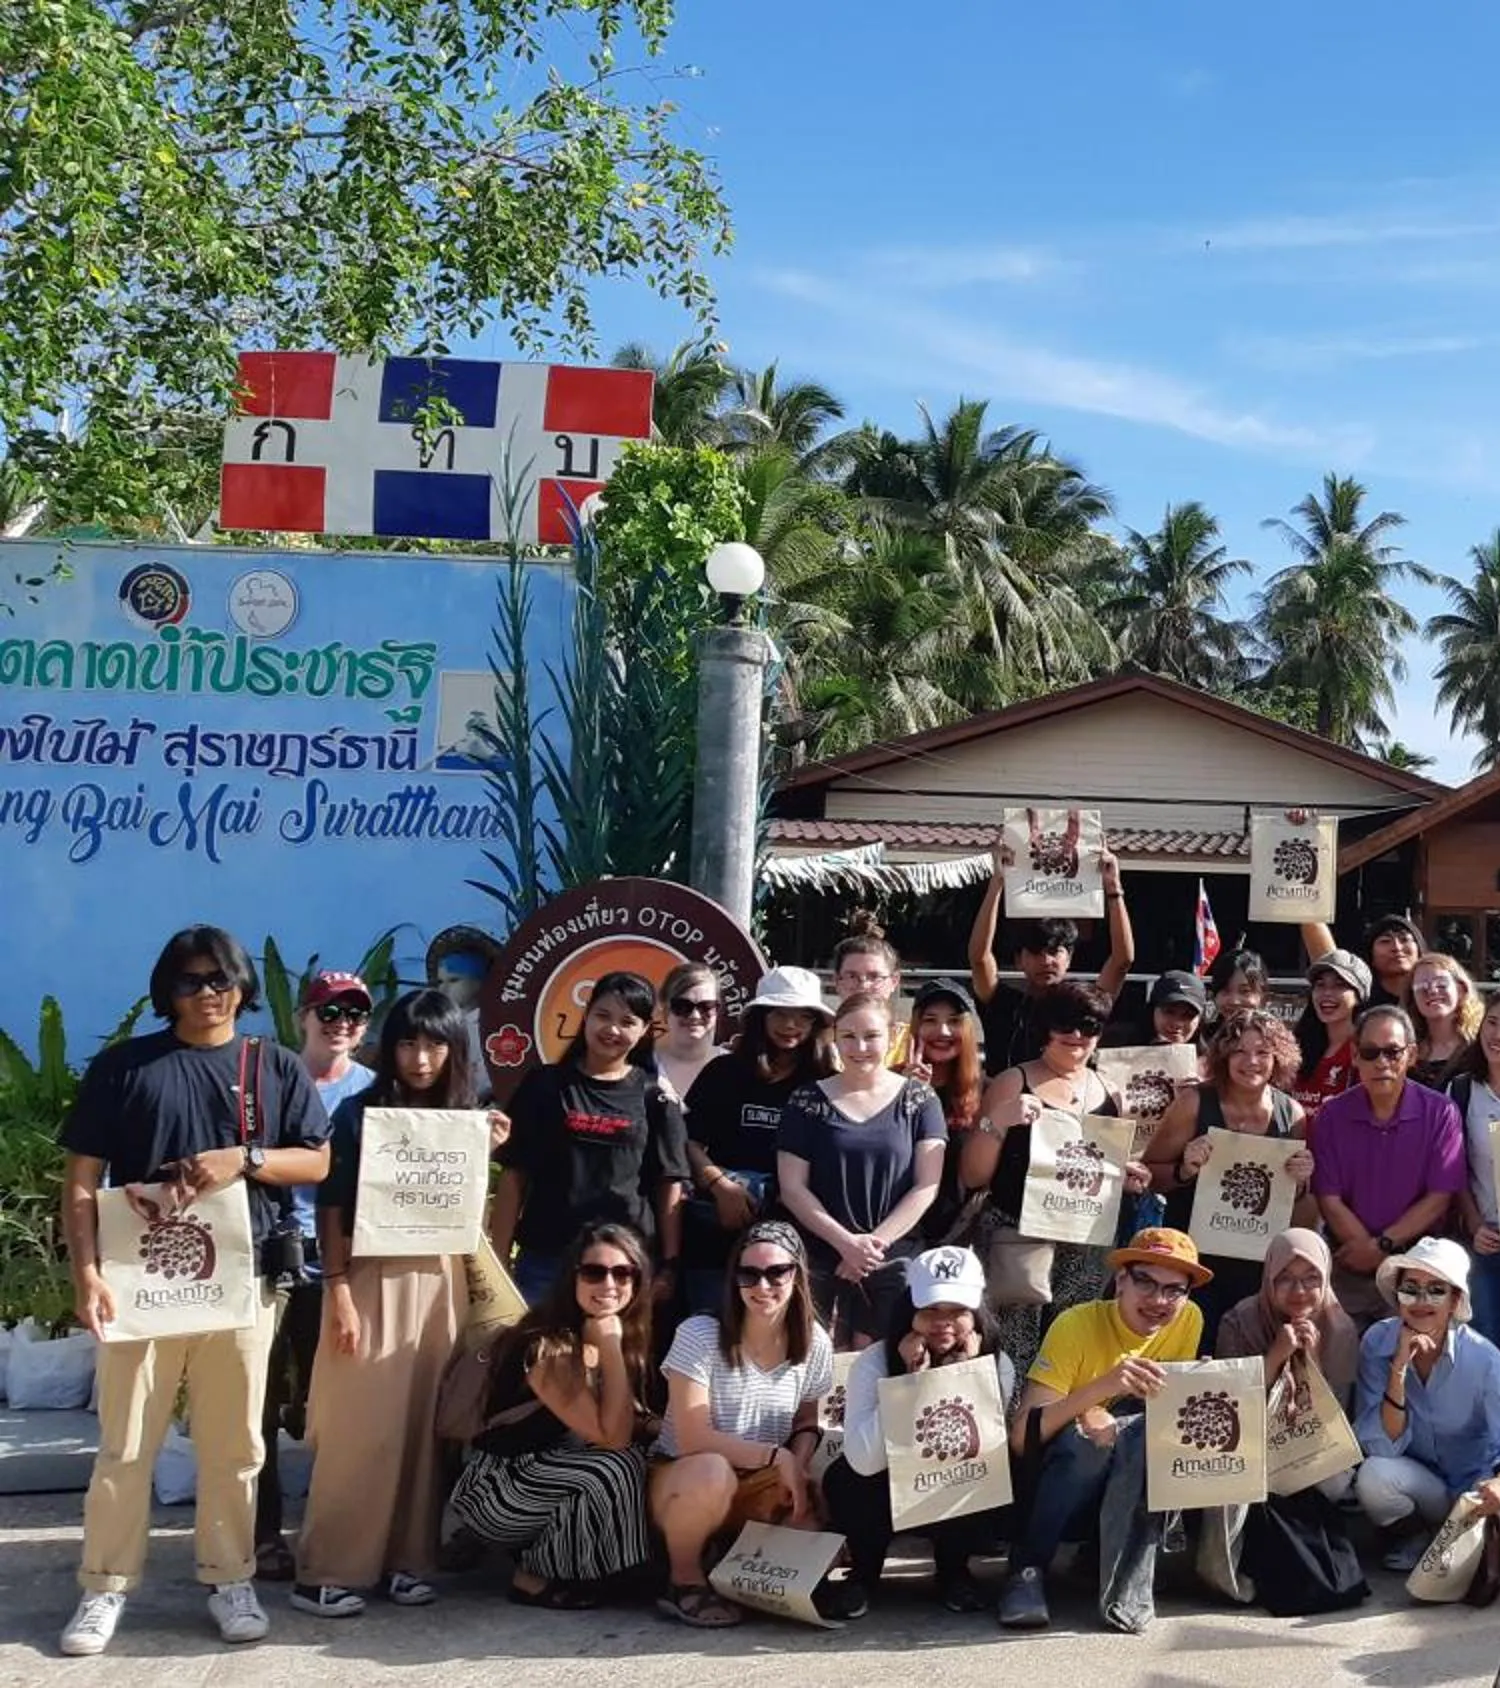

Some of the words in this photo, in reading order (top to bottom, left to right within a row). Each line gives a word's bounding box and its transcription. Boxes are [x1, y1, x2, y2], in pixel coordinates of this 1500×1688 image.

[251, 419, 296, 463] ก
[554, 433, 600, 479] บ
[0, 626, 438, 723] ตลาดน้ำประชารัฐ
[61, 783, 150, 862] Bai
[150, 781, 263, 864] Mai
[279, 777, 503, 844] Suratthan
[638, 906, 704, 944] OTOP
[134, 1282, 224, 1310] Amantra
[914, 1460, 988, 1493] Amantra
[1171, 1456, 1246, 1479] Amantra
